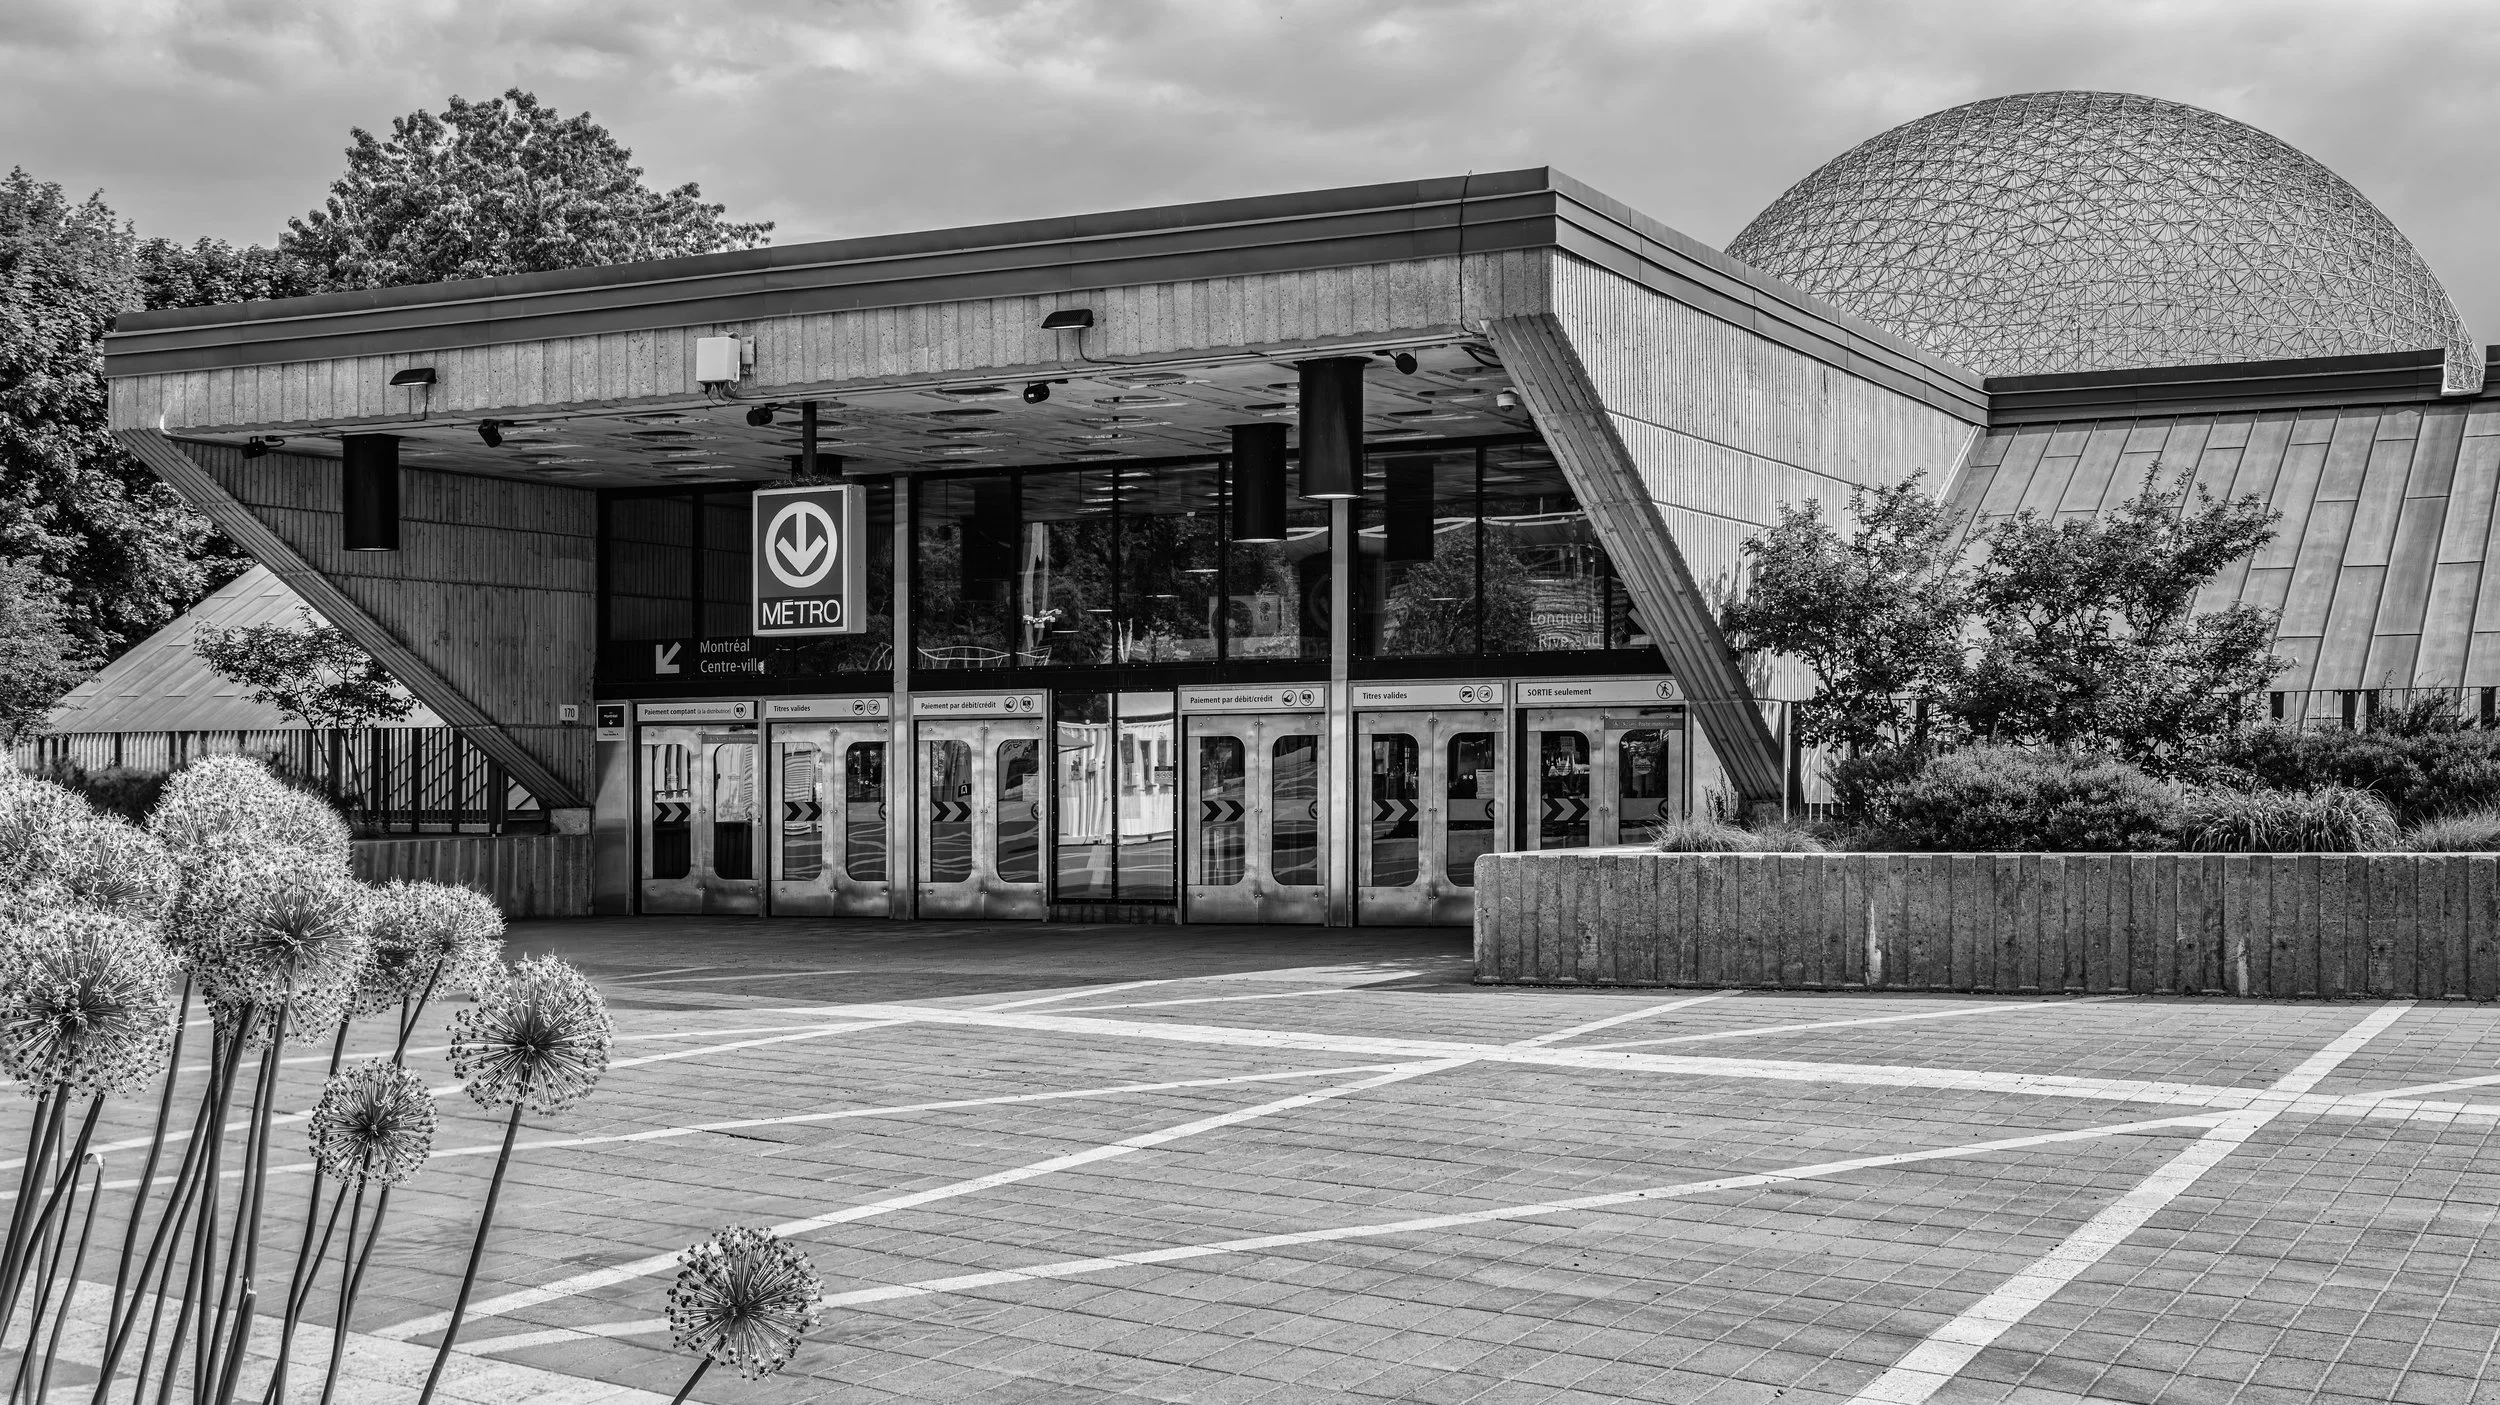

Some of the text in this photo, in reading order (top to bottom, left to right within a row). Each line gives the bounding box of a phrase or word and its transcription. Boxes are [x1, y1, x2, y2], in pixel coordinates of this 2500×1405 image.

[1530, 608, 1600, 628] Longueuil
[700, 638, 750, 653] Montréal
[700, 657, 764, 674] Centre-ville
[1362, 691, 1408, 700] Titres valides
[1527, 687, 1592, 697] SORTIE seulement
[1190, 695, 1273, 705] Paiement par débit/crédit
[790, 704, 811, 712] valides
[921, 702, 949, 710] Paiement
[949, 703, 960, 711] par
[564, 707, 576, 719] 170
[644, 708, 670, 716] Paiement
[670, 708, 697, 717] comptant
